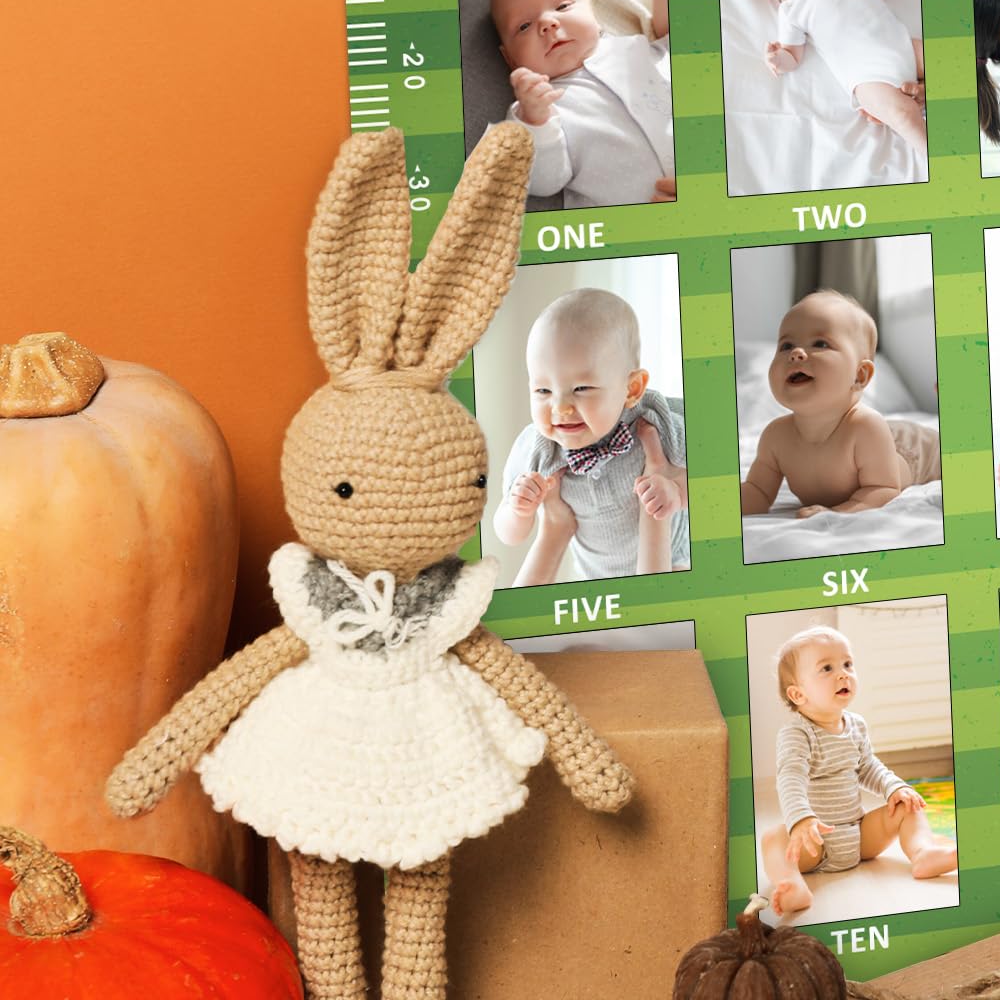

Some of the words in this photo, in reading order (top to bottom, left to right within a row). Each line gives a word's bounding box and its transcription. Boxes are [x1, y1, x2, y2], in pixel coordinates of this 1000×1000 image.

[402, 51, 426, 91] 20
[408, 175, 431, 212] 30
[791, 201, 869, 233] TWO
[536, 221, 606, 252] ONE
[822, 567, 870, 598] SIX
[553, 593, 622, 626] FIVE
[829, 924, 890, 956] TEN
